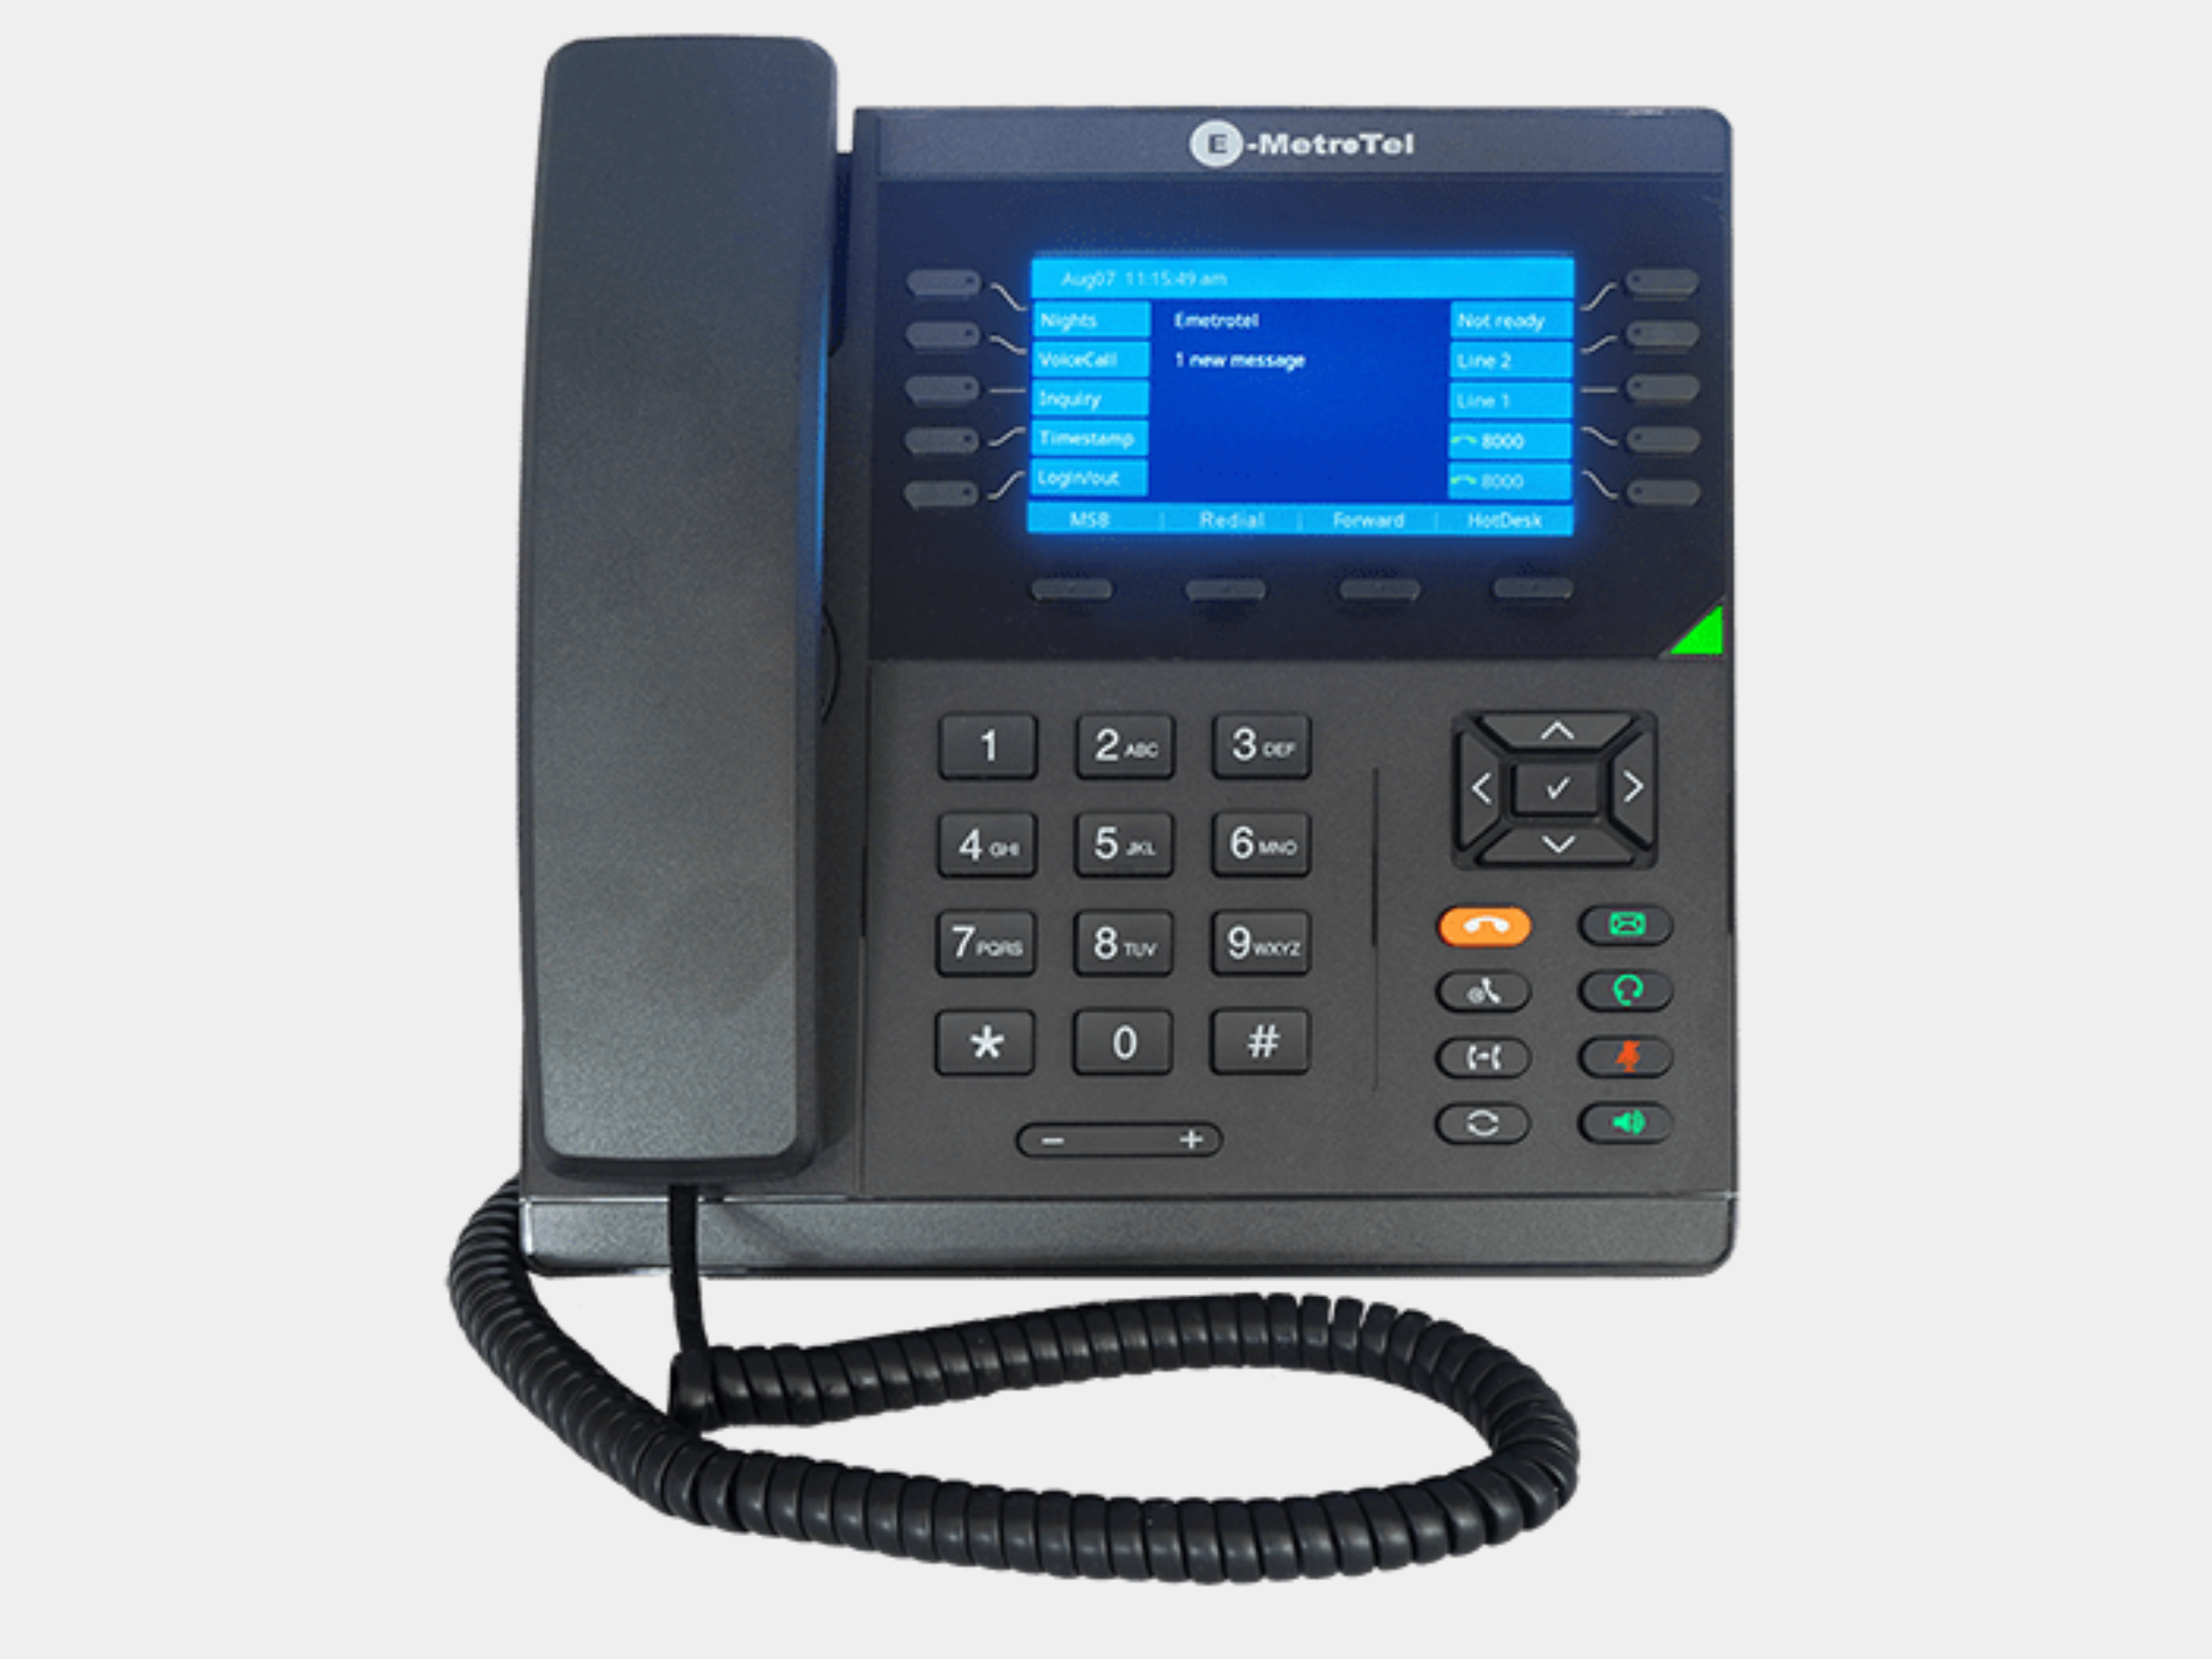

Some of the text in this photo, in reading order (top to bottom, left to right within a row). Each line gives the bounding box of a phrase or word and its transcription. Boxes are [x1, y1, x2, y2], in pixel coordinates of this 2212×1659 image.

[1060, 271, 1228, 290] Aug07 11:15:49 am
[1040, 312, 1097, 332] Nights
[1174, 312, 1259, 328] Emetrotel
[1457, 313, 1545, 333] Not ready
[1038, 352, 1117, 367] VoiceCall
[1176, 352, 1306, 373] 1 new message
[1457, 351, 1512, 369] Line 2
[1040, 391, 1101, 410] Inquiry
[1457, 393, 1510, 409] Line 1
[1039, 430, 1135, 449] Timestamp
[1481, 433, 1524, 450] 8000
[1038, 470, 1120, 489] Login/out
[1481, 473, 1524, 490] 8000
[1199, 511, 1266, 528] Redial
[1333, 511, 1405, 528] Forward
[1469, 511, 1542, 529] HotDesk
[981, 729, 996, 762] 1
[1095, 728, 1159, 762] 2 ABC
[1233, 727, 1297, 761] 3 DEF
[959, 828, 1020, 861] 4 GHI
[1095, 826, 1156, 860] 5 JKL
[1229, 826, 1298, 859] 6 MNO
[951, 926, 1024, 959] 7 PQRS
[1094, 926, 1158, 960] 8 TUV
[1227, 926, 1300, 959] 9 WXYZ
[1113, 1026, 1138, 1060] 0
[1248, 1024, 1281, 1059] #
